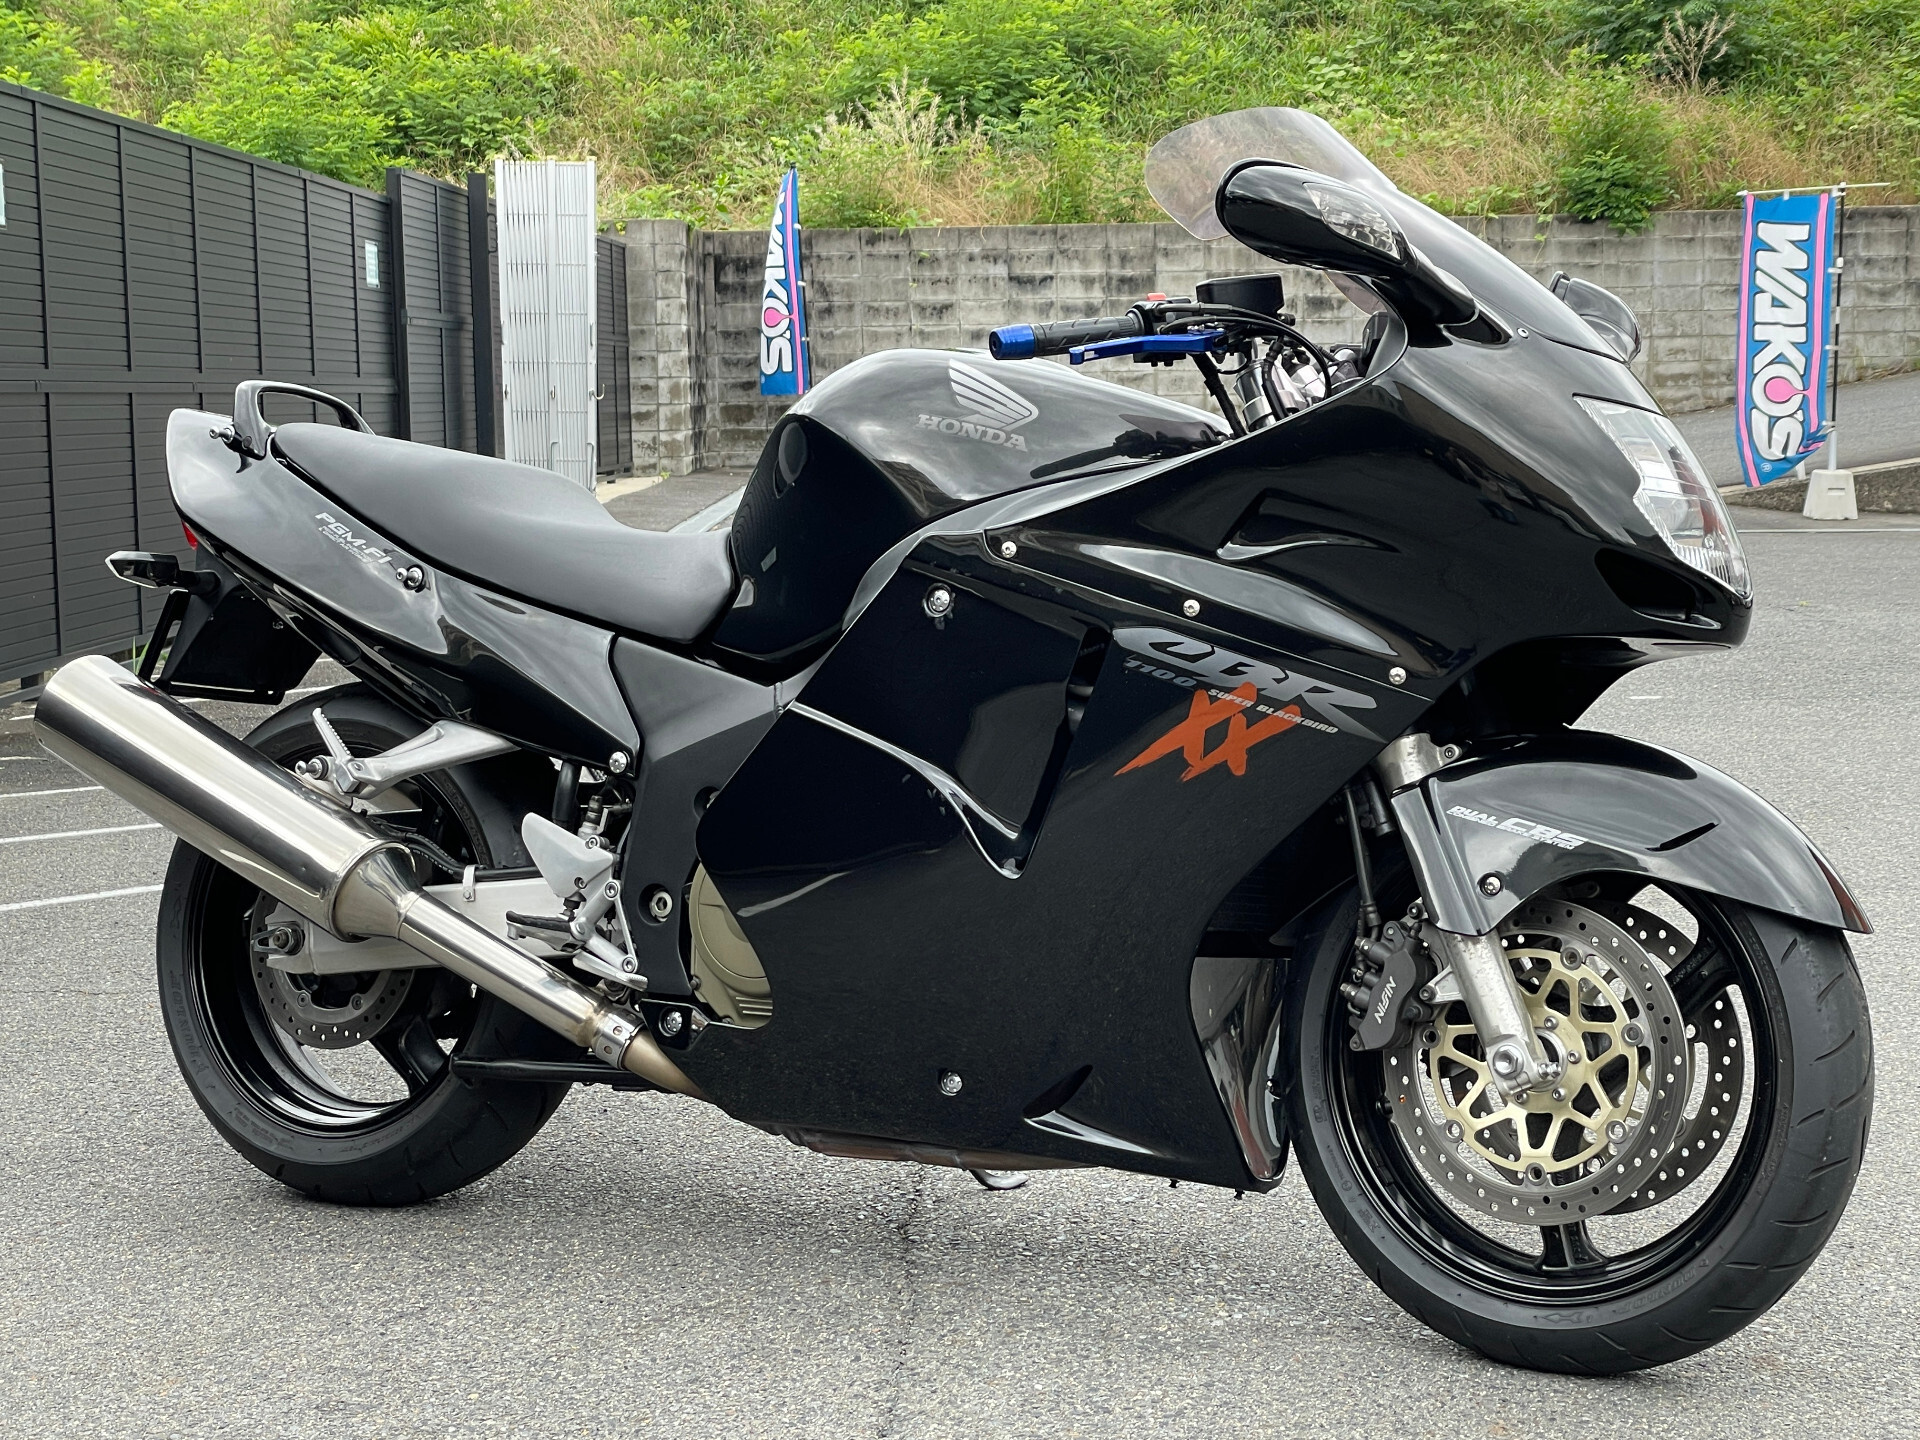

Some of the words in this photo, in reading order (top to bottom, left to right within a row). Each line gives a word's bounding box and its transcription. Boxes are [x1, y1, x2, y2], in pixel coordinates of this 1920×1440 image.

[1751, 222, 1810, 461] WAKO'S
[914, 413, 1029, 452] HONDA
[315, 512, 392, 564] PGM-FI
[1112, 626, 1389, 744] CBR
[1123, 654, 1197, 688] 1100
[1113, 681, 1302, 782] XX
[1207, 688, 1255, 708] SUPER
[1255, 704, 1339, 734] BLACKBIRD
[1447, 805, 1499, 825] DUAL
[1497, 817, 1589, 847] CBS
[1374, 975, 1397, 1025] NISSIN
